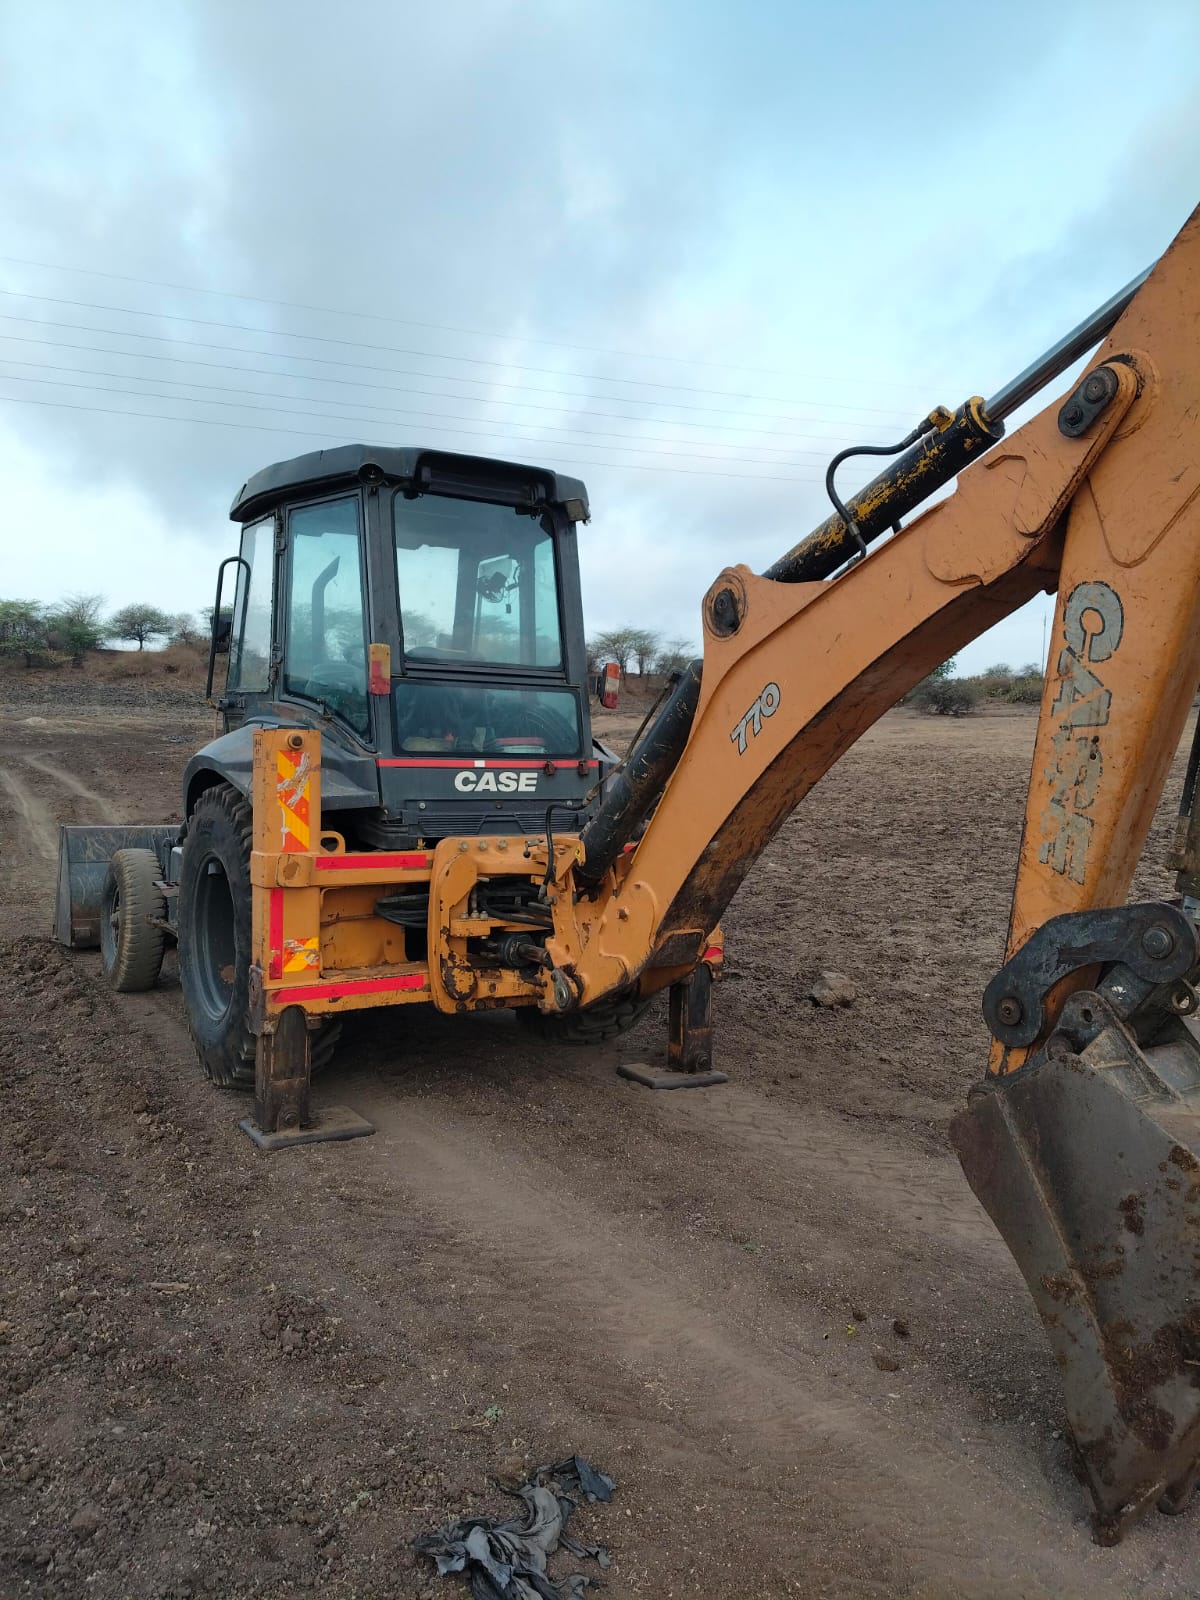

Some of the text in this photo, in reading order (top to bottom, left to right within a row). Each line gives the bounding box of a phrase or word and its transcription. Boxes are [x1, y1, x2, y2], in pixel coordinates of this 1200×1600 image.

[730, 682, 781, 756] 770
[1038, 580, 1125, 885] CASE
[454, 771, 538, 792] CASE
